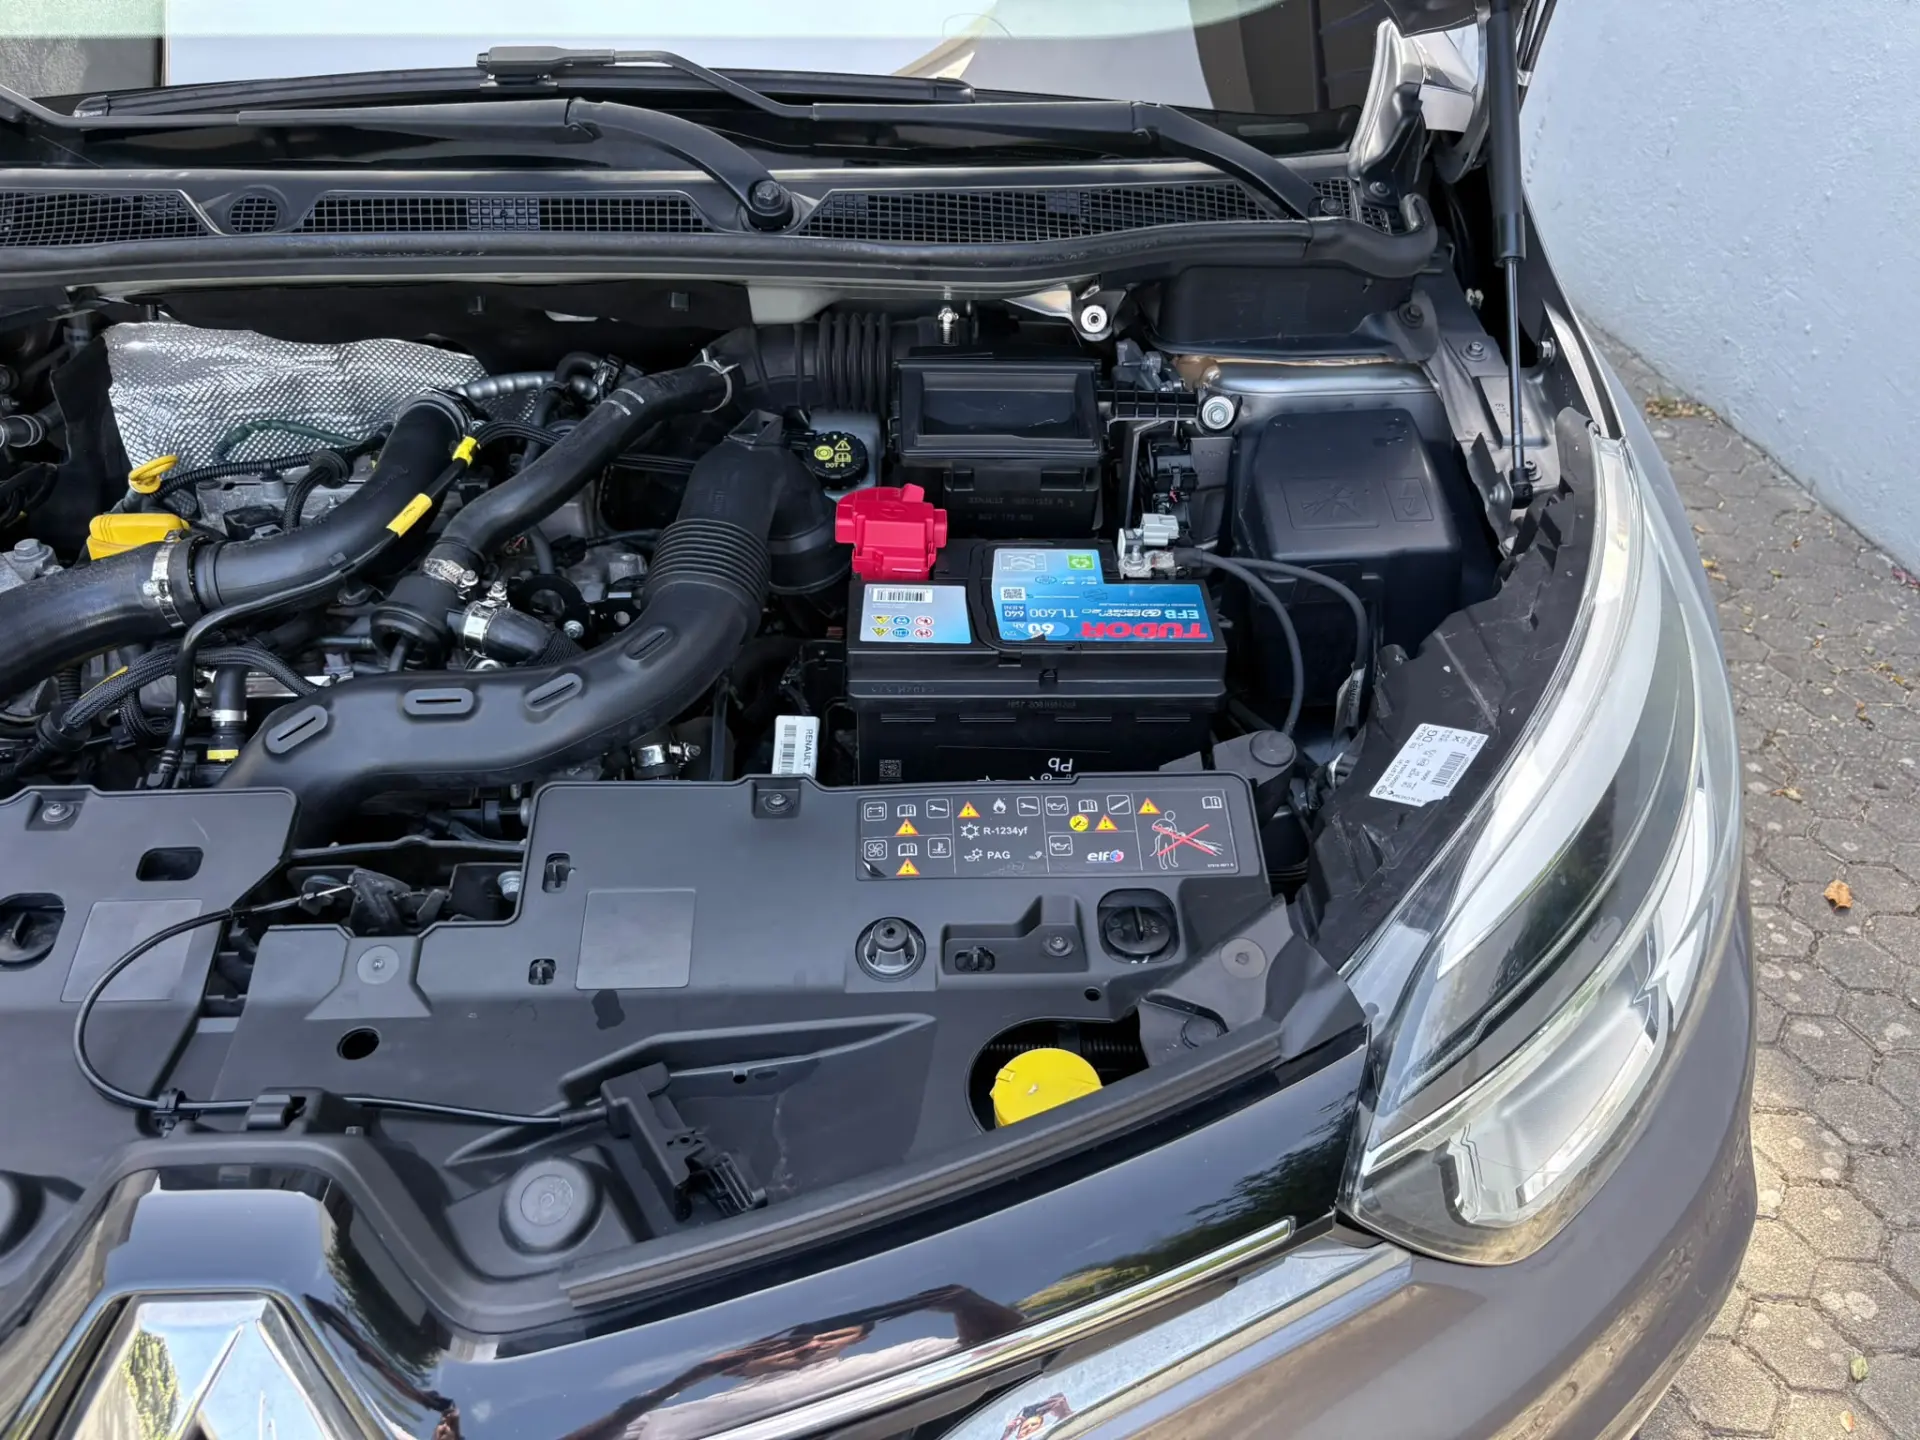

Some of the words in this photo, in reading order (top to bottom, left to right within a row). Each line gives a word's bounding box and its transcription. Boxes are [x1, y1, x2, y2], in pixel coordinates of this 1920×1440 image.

[1029, 608, 1078, 618] TL600
[1163, 609, 1200, 619] EFB
[1028, 622, 1054, 636] 60
[1081, 621, 1208, 639] TUDOR
[1422, 729, 1438, 743] DG
[803, 728, 814, 769] RENAULT
[1048, 757, 1073, 772] Pb
[983, 827, 1028, 836] R-1234yf
[987, 851, 1011, 860] PAG
[1087, 851, 1110, 862] elf
